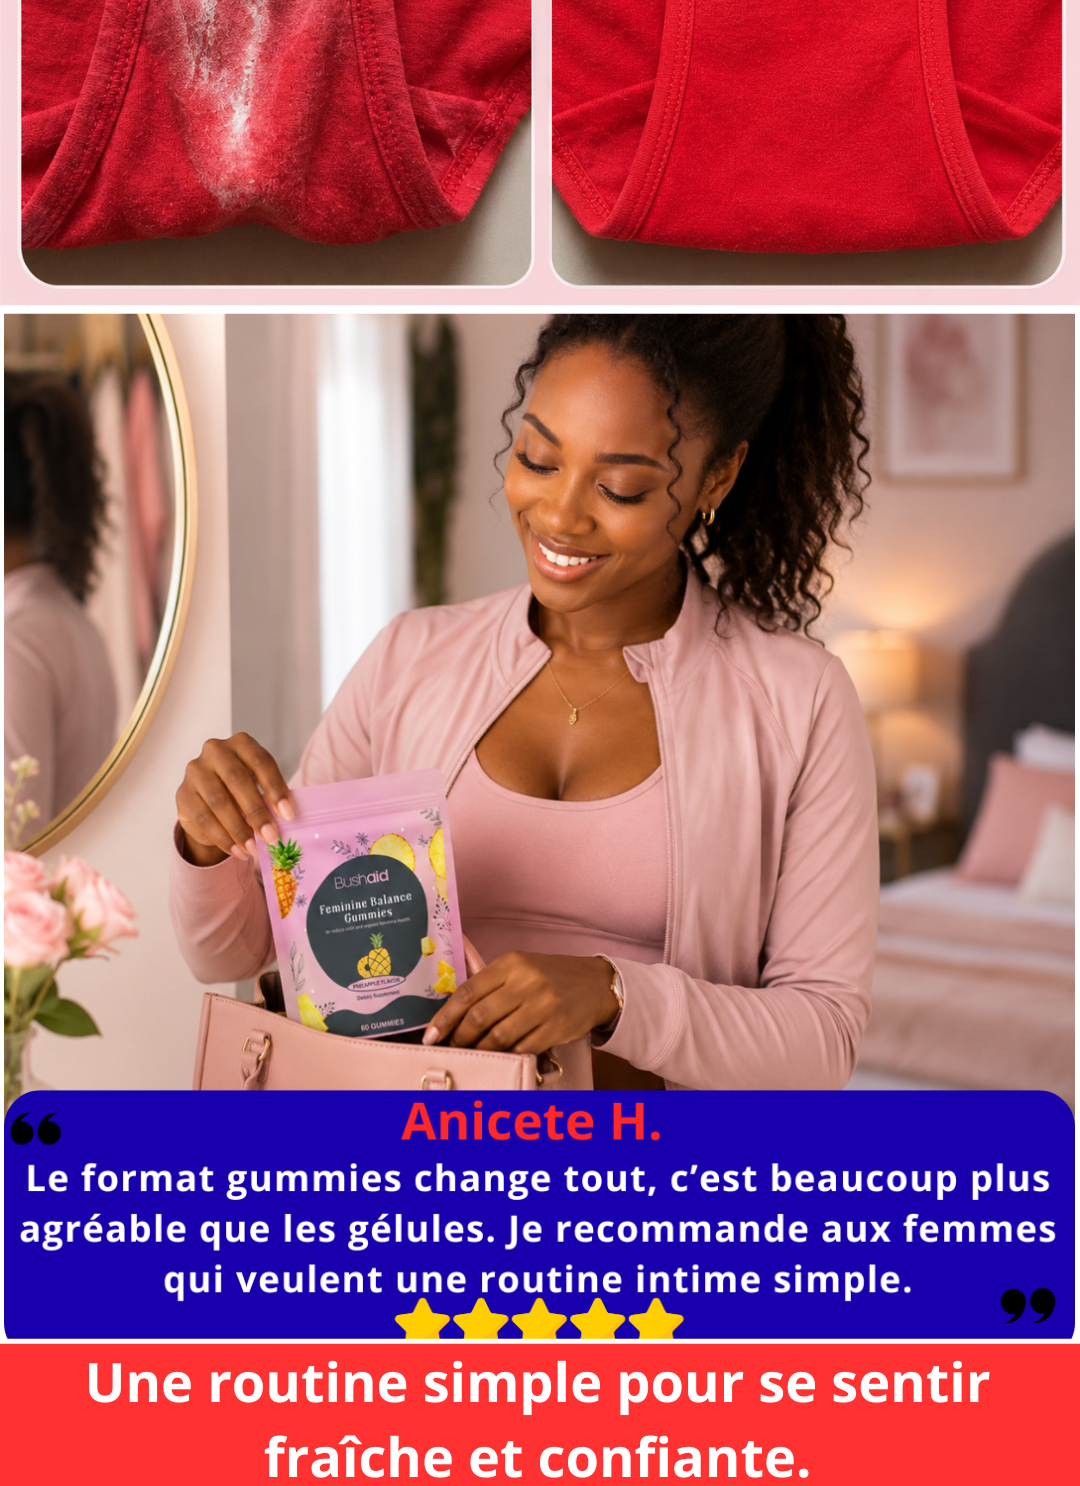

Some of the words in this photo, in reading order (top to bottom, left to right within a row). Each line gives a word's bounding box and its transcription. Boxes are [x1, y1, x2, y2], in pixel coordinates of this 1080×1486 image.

[334, 869, 390, 890] Bushaid
[319, 900, 368, 915] Feminine
[370, 893, 413, 907] Balance
[344, 908, 393, 923] Gummies
